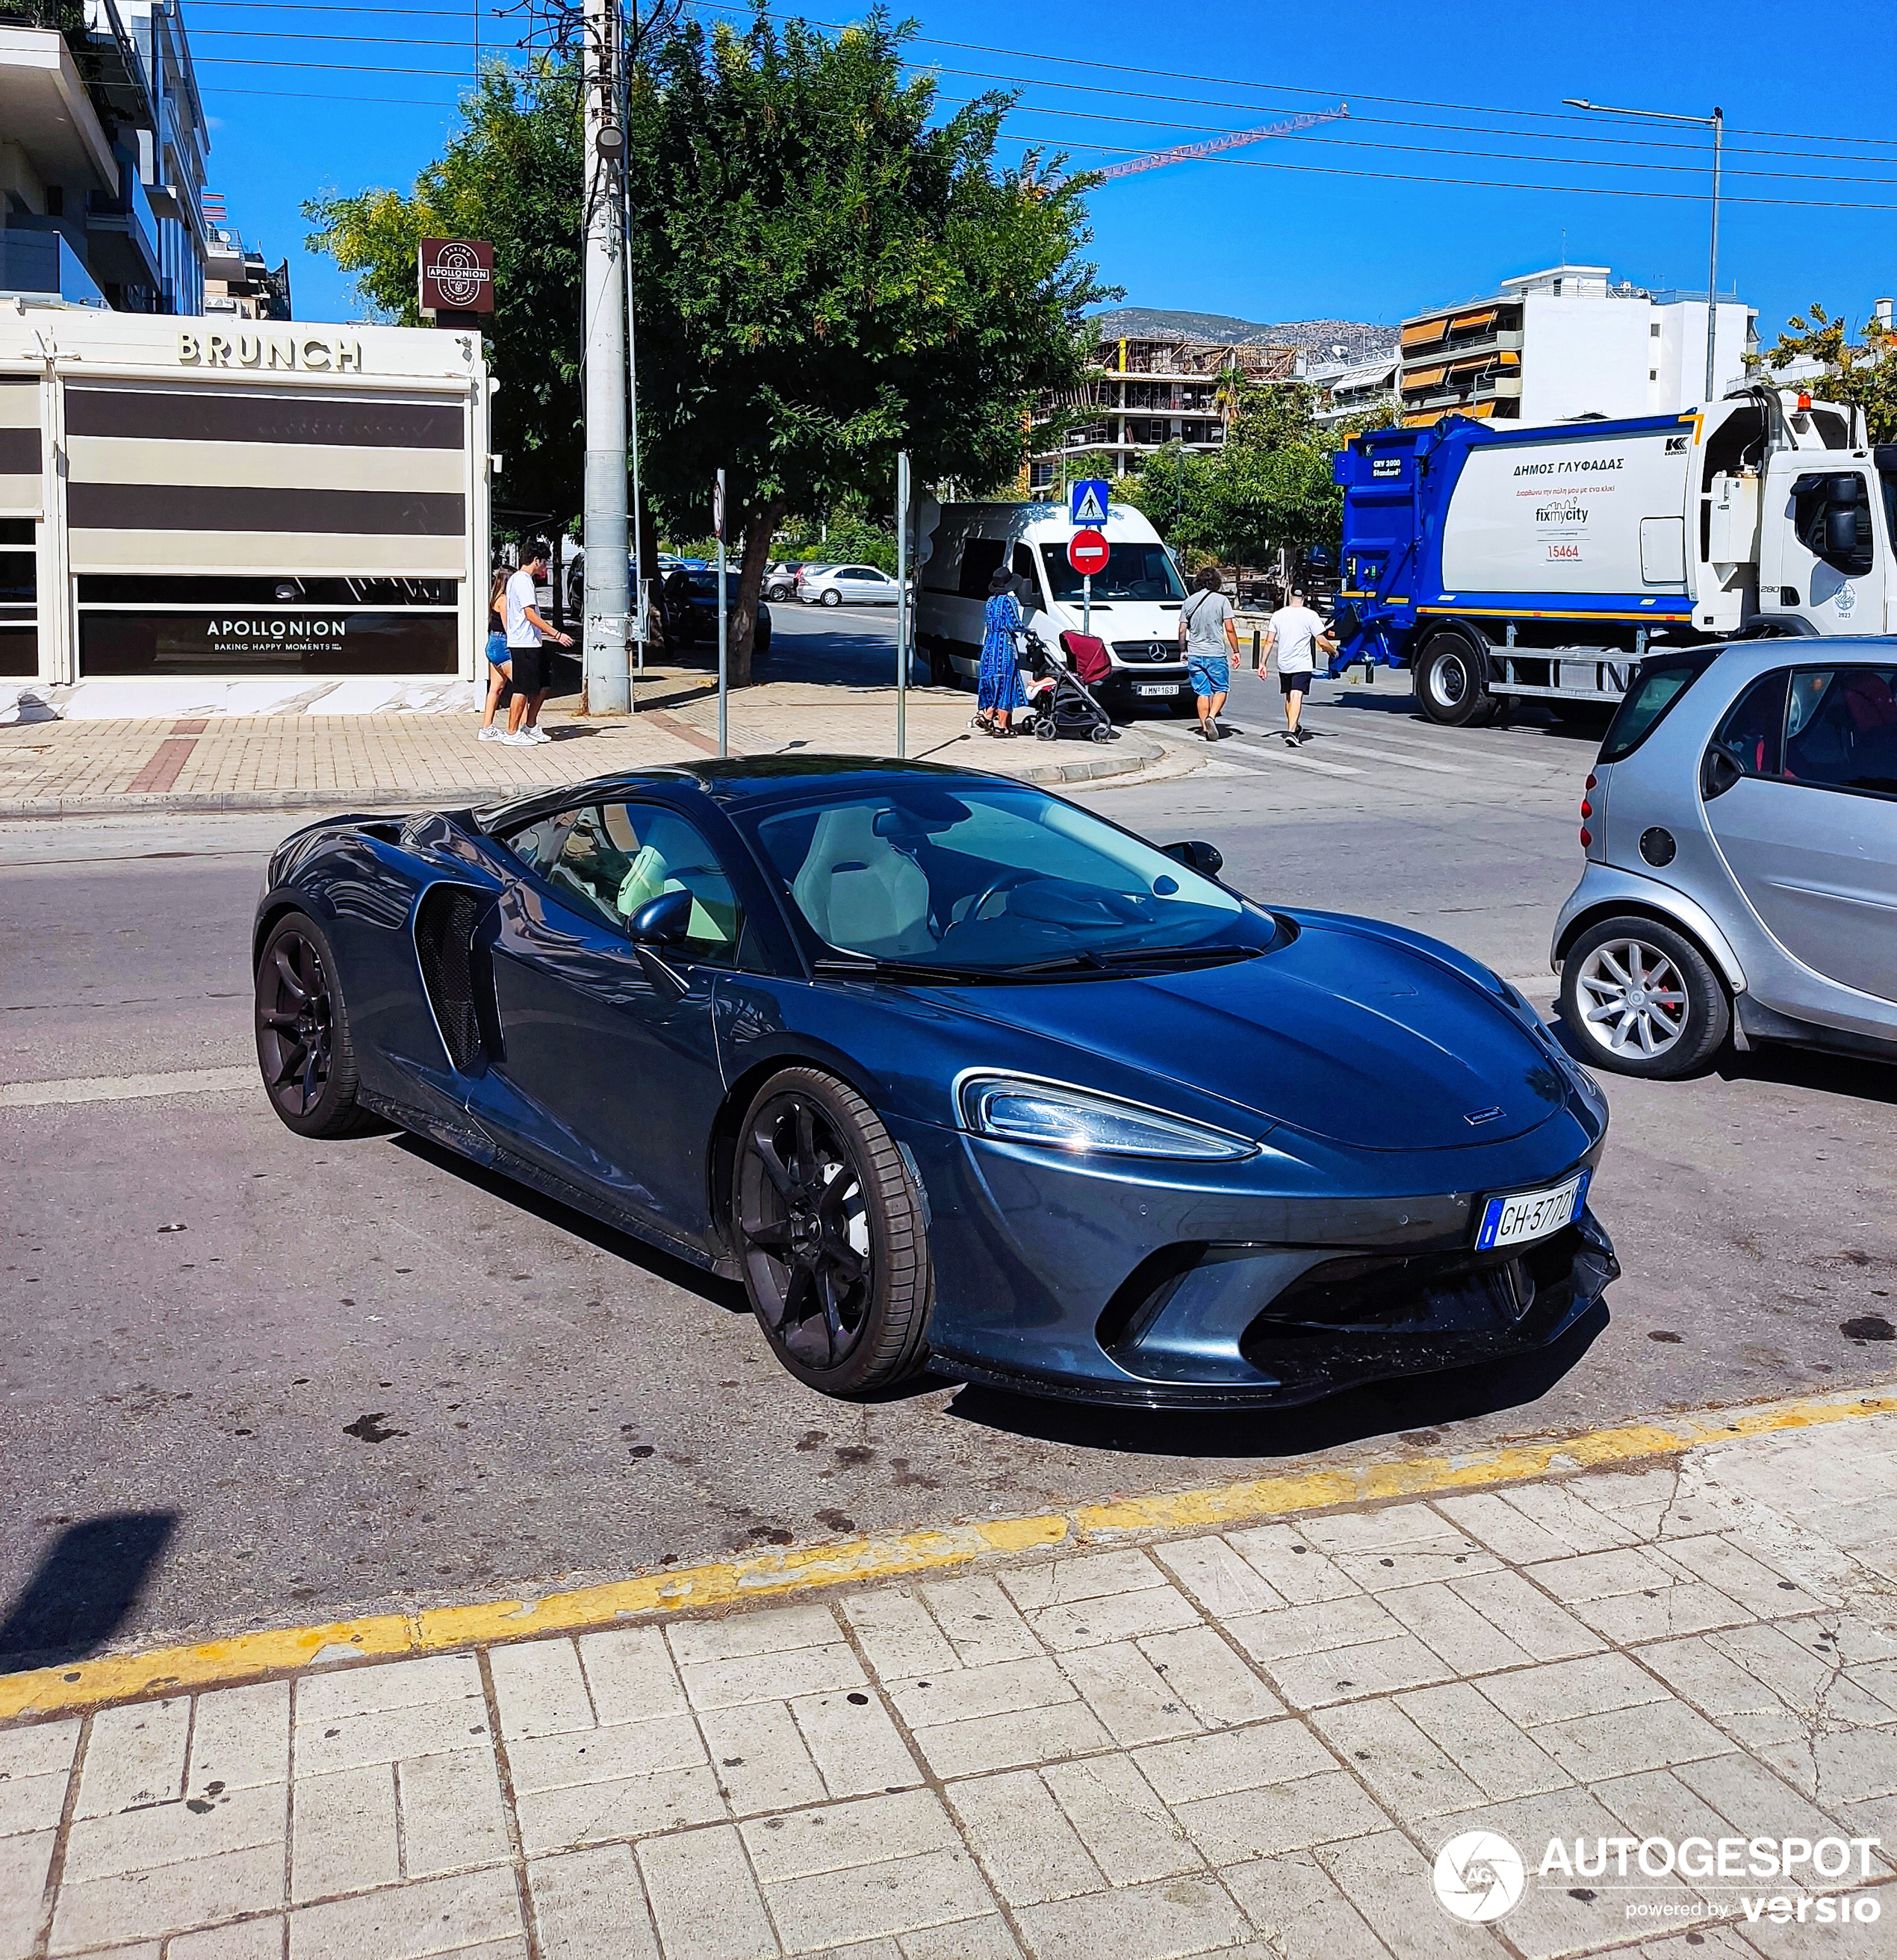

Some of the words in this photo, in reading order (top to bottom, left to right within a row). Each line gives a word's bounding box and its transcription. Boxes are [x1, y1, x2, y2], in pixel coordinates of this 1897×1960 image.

[444, 246, 471, 257] BAKING
[429, 268, 487, 279] APOLLONION
[177, 331, 360, 370] BRUNCH
[1513, 463, 1555, 476] ΔΗΜΟΣ
[1557, 458, 1624, 473] ΓΛΥΦΑΔΑΣ
[1536, 508, 1589, 524] fixmycity
[1547, 545, 1579, 558] 15464
[207, 620, 346, 639] APOLLONION
